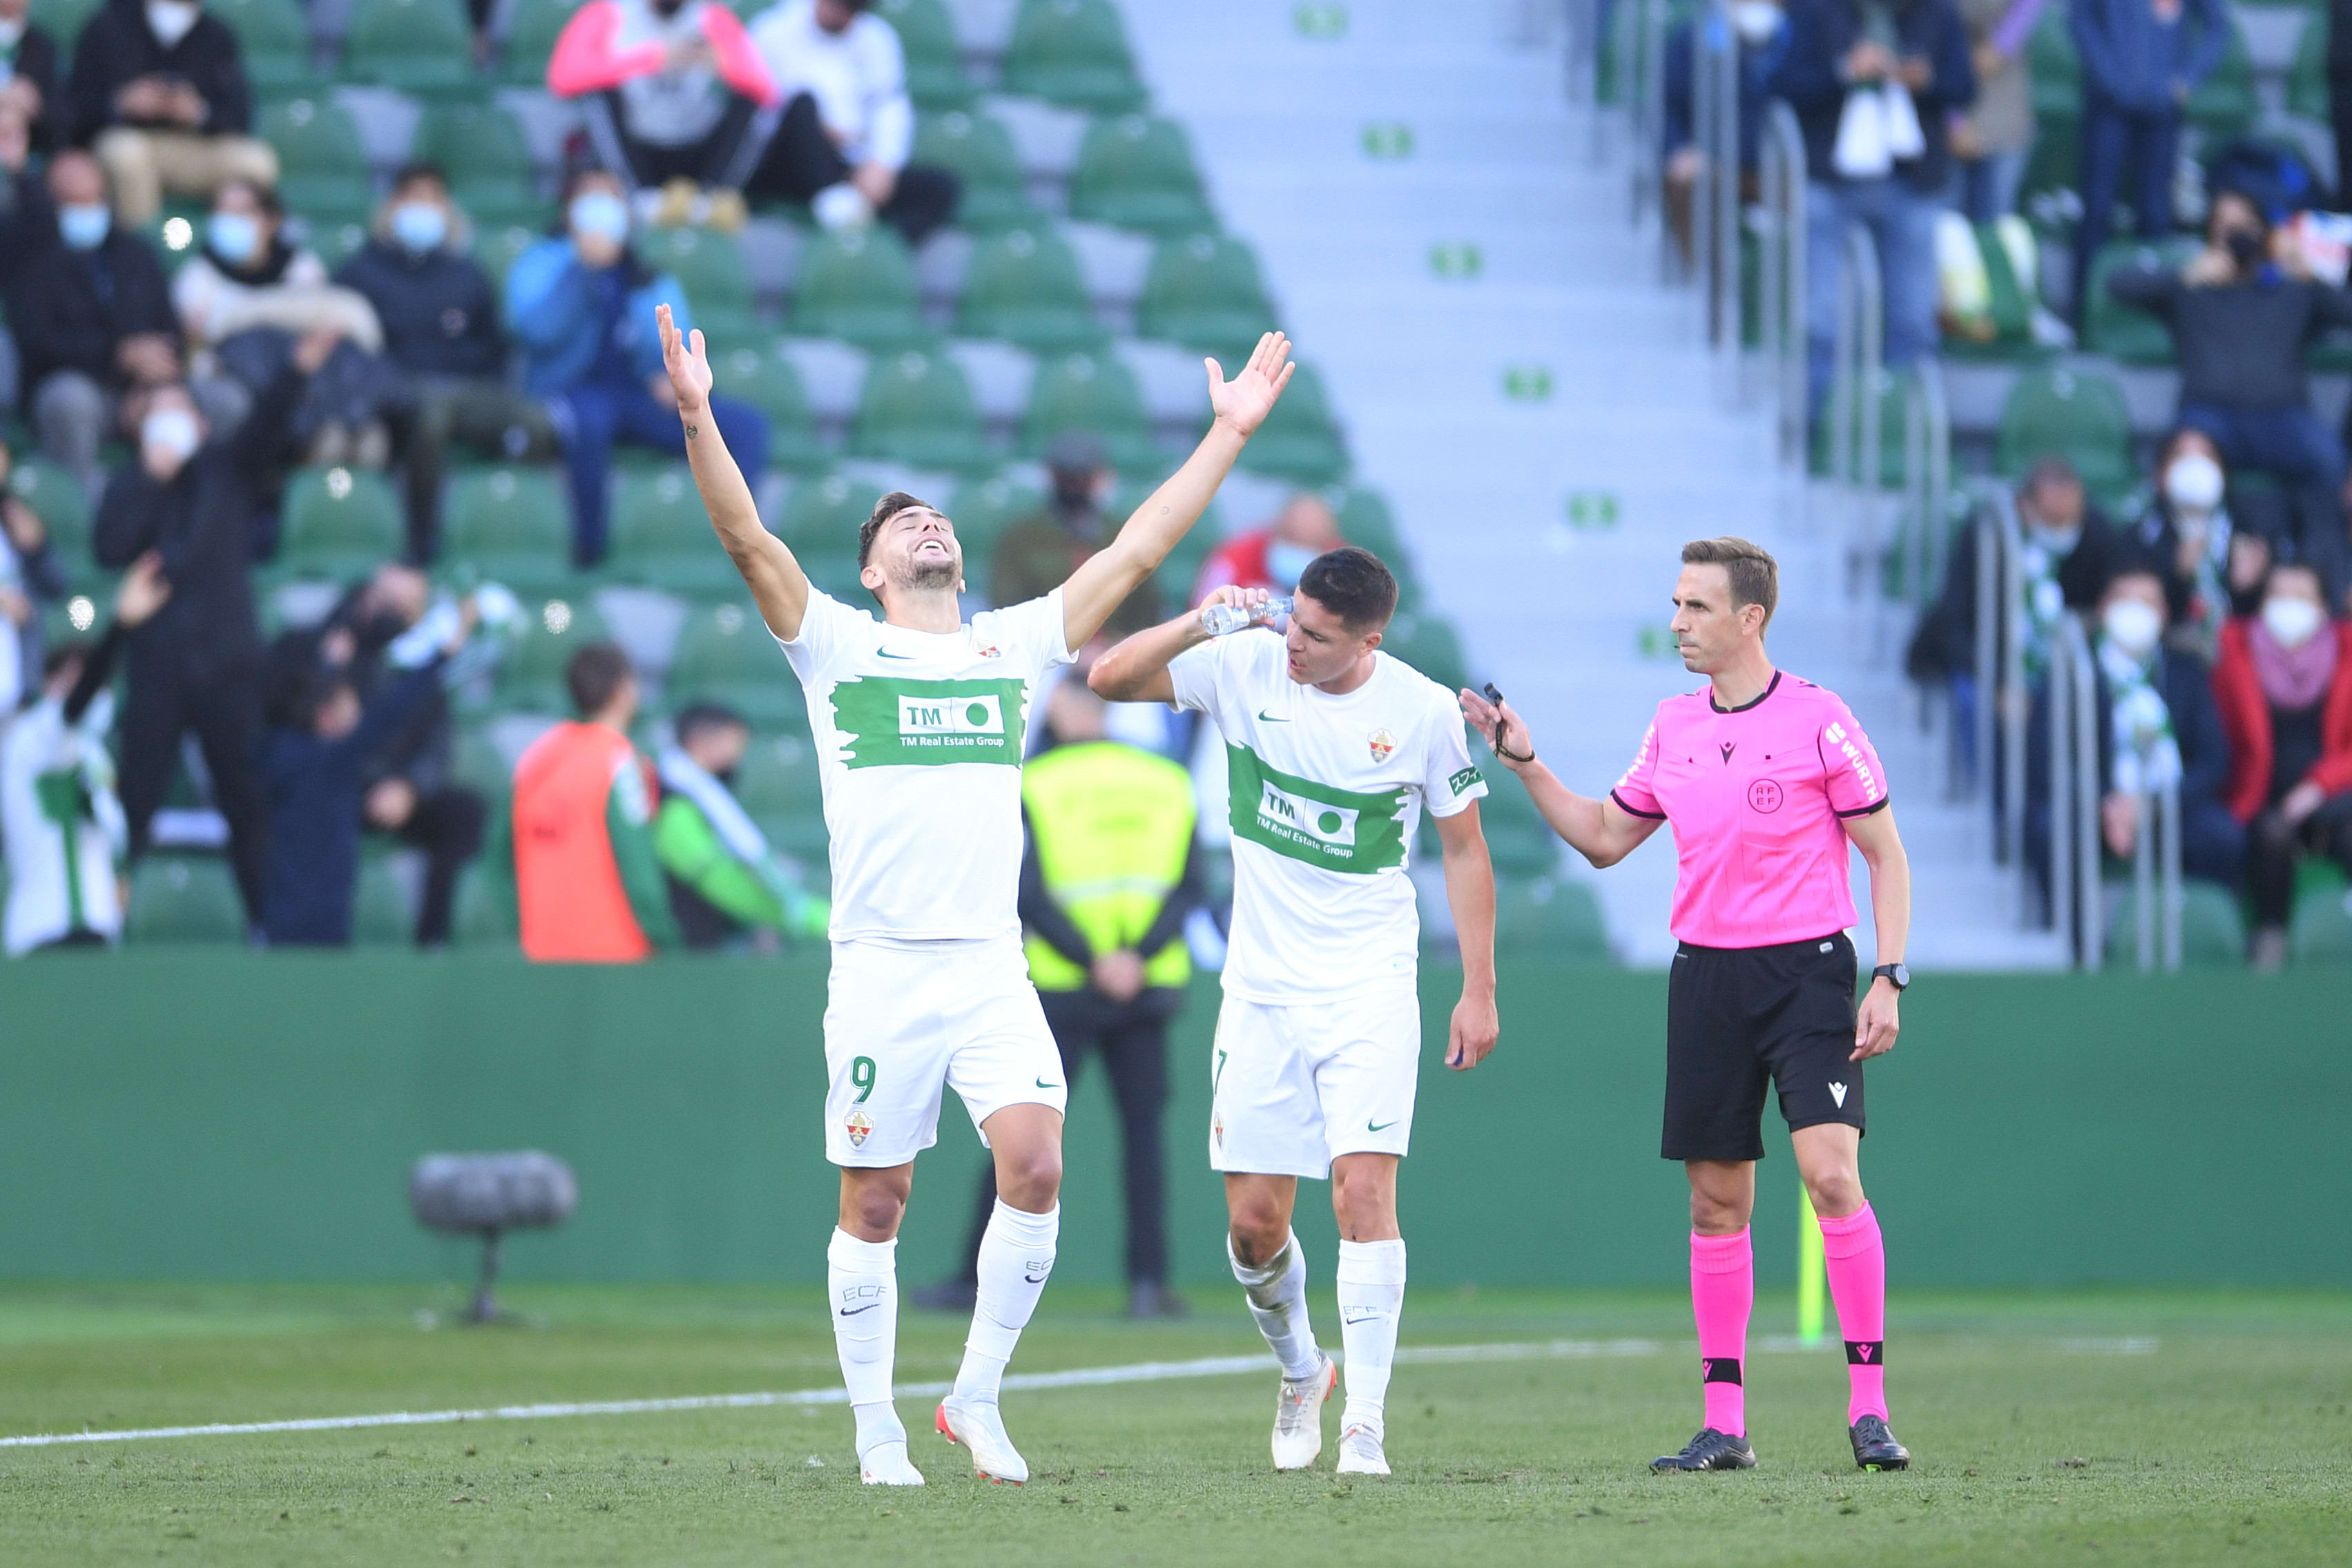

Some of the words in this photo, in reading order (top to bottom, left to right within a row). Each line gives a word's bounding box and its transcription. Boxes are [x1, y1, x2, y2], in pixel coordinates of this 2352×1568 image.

[907, 706, 943, 725] TM
[900, 737, 918, 746] TM
[919, 736, 941, 746] Real
[943, 736, 974, 746] Estate
[976, 736, 1005, 748] Group
[1841, 739, 1879, 802] WÜRTH
[1268, 791, 1295, 820] TM
[1256, 815, 1271, 831] TM
[1271, 824, 1291, 839] Real
[1293, 832, 1320, 850] Estate
[1323, 844, 1353, 859] Group
[850, 1055, 876, 1105] 9
[842, 1285, 887, 1302] ECF
